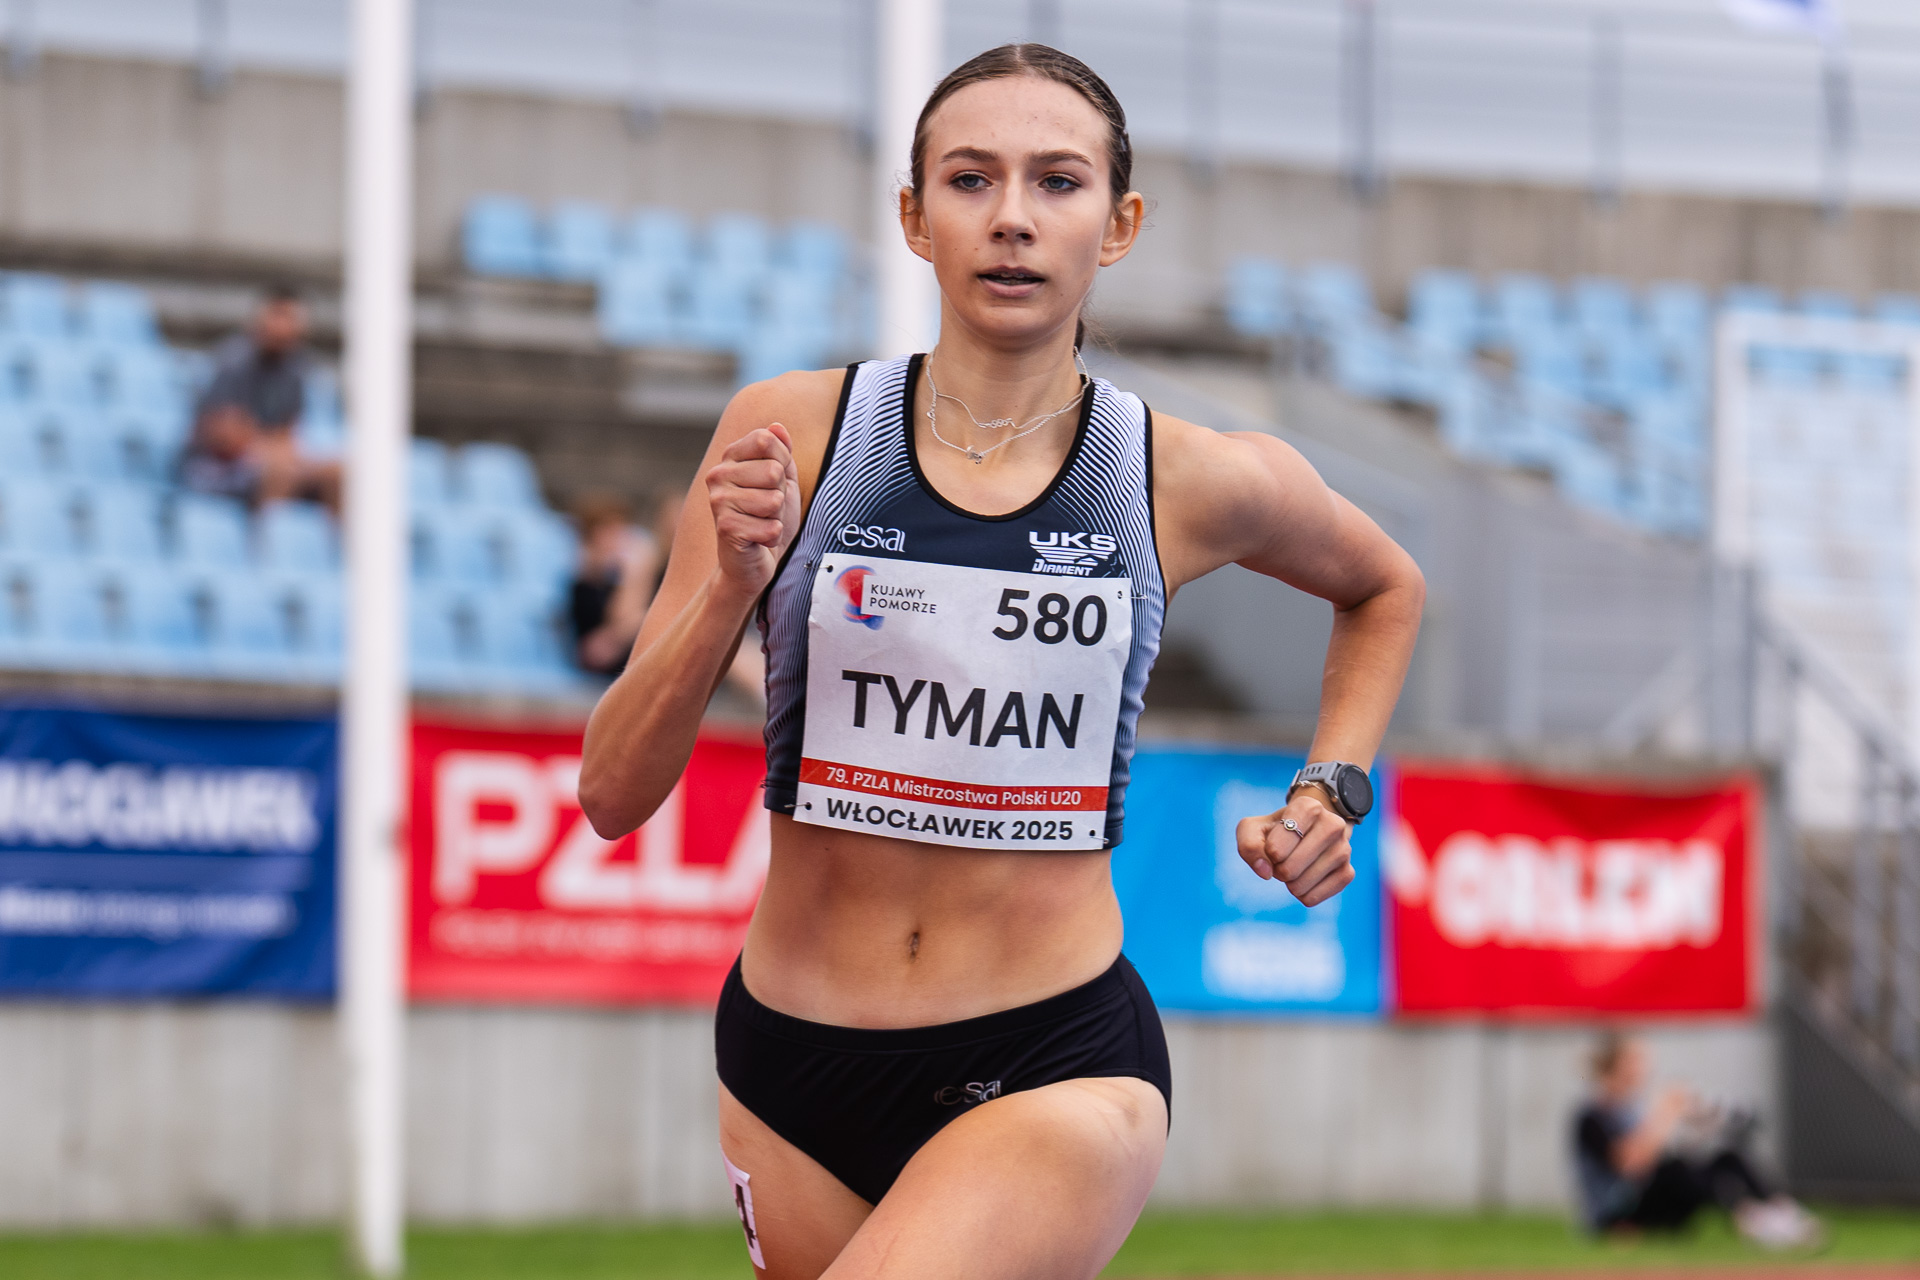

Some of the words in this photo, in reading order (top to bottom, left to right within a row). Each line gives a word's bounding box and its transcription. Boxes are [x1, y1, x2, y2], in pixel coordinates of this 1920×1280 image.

[837, 523, 906, 553] esa
[1029, 531, 1117, 552] UKS
[869, 597, 937, 614] POMORZE
[870, 584, 925, 599] KUJAWY
[992, 588, 1108, 646] 580
[841, 669, 1084, 749] TYMAN
[826, 766, 849, 785] 79.
[852, 772, 890, 792] PZLA
[893, 779, 998, 805] Mistrzostwa
[1001, 790, 1048, 806] Polski
[1050, 791, 1082, 806] U20
[826, 797, 1006, 841] WŁOCŁAWEK
[1010, 820, 1073, 841] 2025
[1430, 832, 1724, 948] ORLEN
